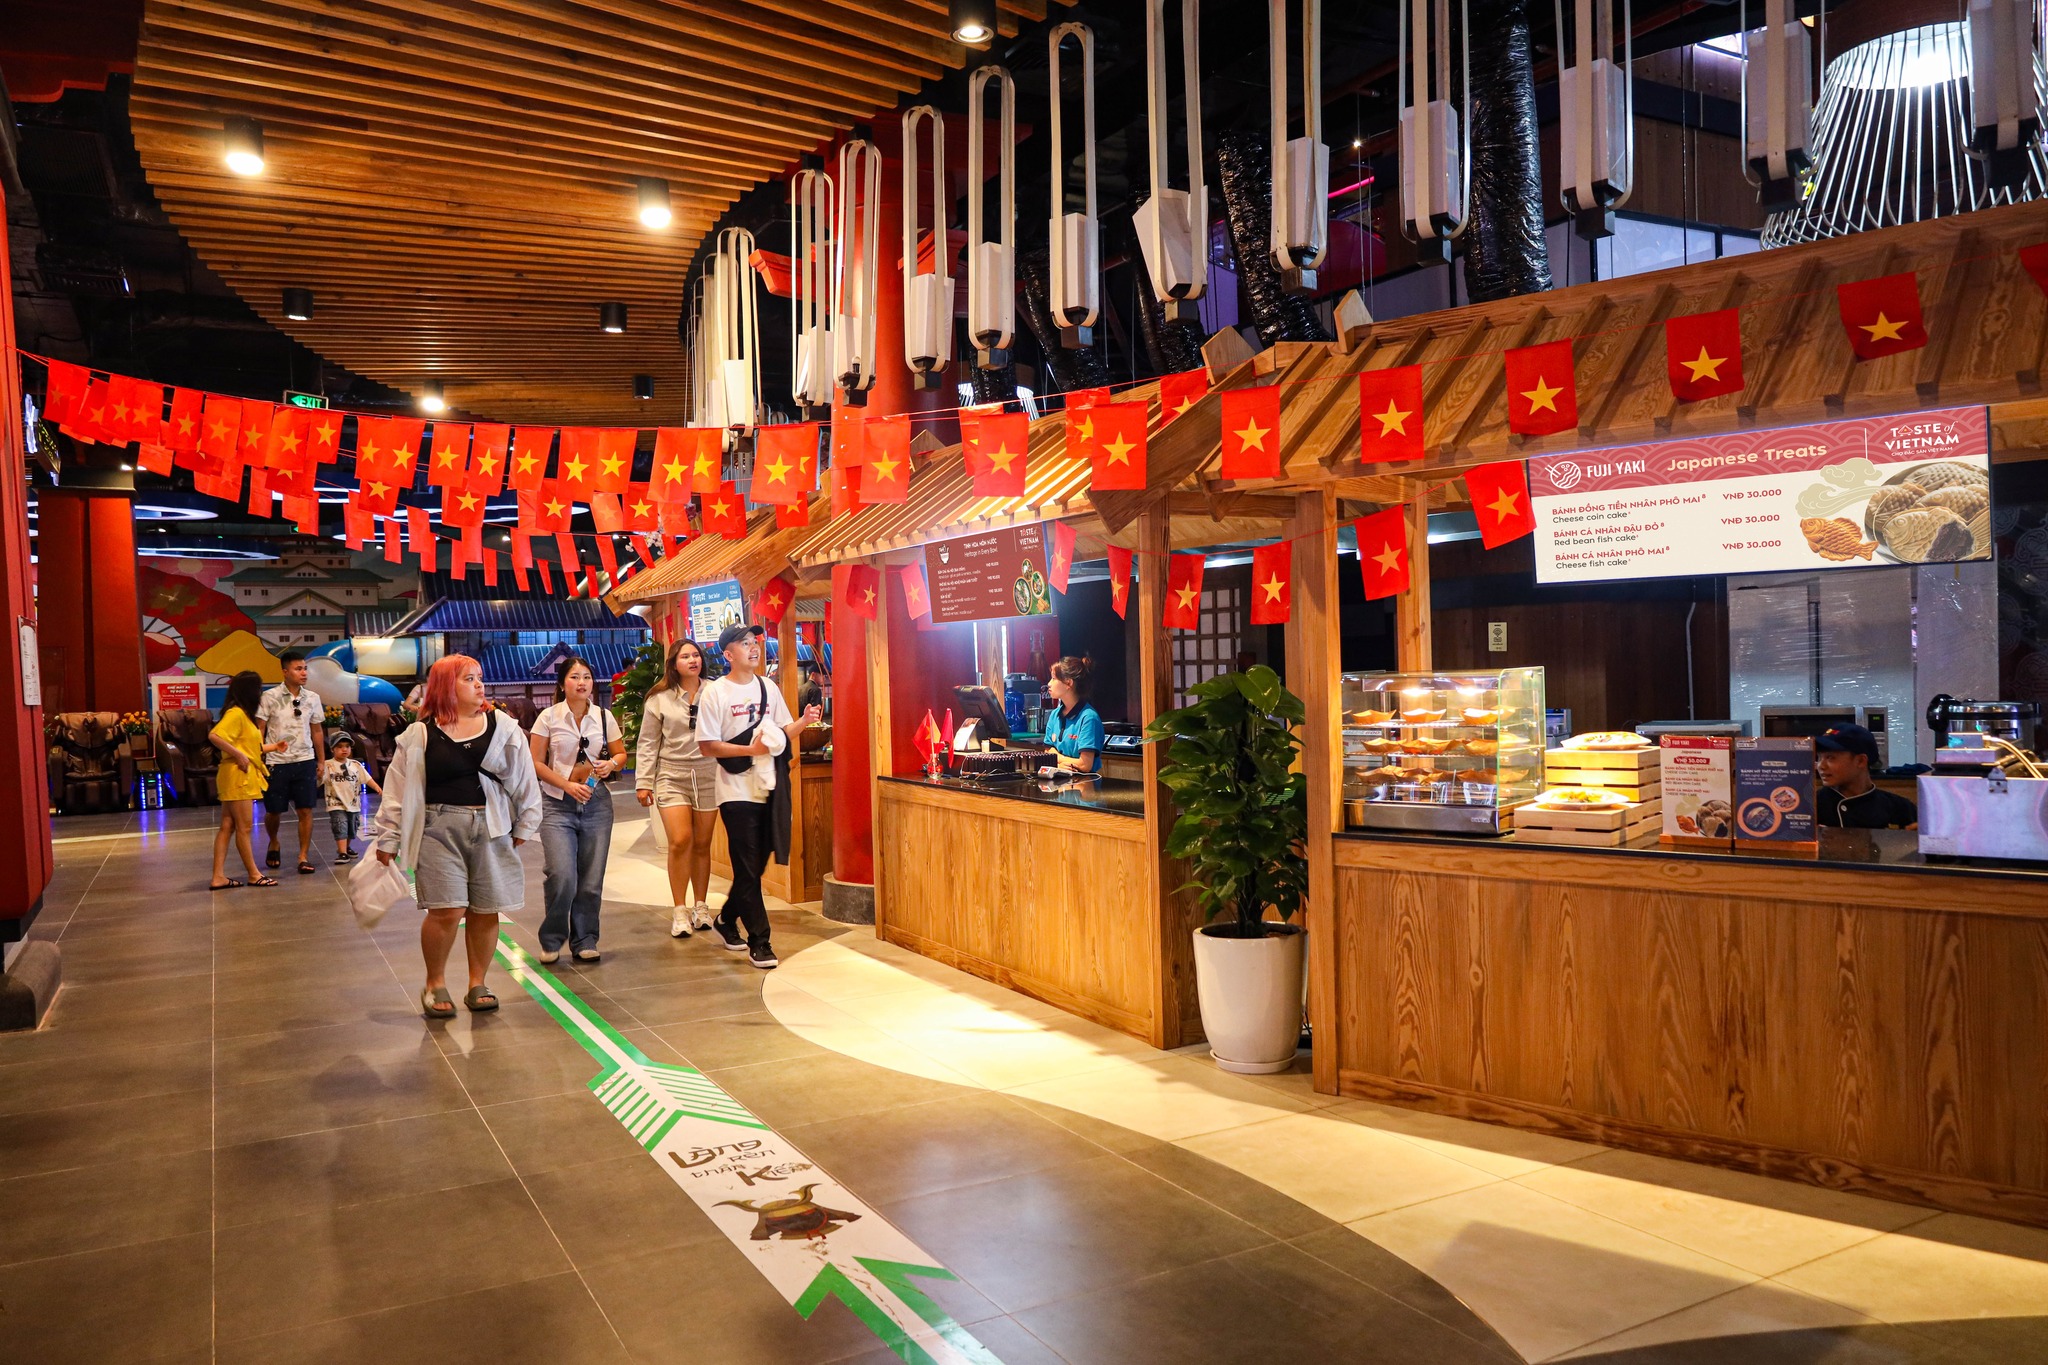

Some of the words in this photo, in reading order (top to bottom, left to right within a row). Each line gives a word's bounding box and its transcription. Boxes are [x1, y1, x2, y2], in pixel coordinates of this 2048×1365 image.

[299, 395, 322, 409] EXIT
[1944, 420, 1958, 434] of
[1884, 434, 1960, 450] VIETNAM
[1667, 452, 1759, 472] Japanese
[1763, 444, 1827, 461] Treats
[1586, 463, 1612, 478] FUJI
[1615, 460, 1646, 474] YAKI
[1722, 491, 1744, 500] VNĐ
[1746, 488, 1782, 499] 30.000
[1552, 506, 1576, 516] BÁNH
[1630, 498, 1657, 509] NHÂN
[1552, 513, 1584, 524] Cheese
[1586, 512, 1604, 521] coin
[1720, 516, 1743, 525] VNĐ
[1745, 514, 1780, 524] 30.000
[1553, 529, 1578, 538] BÁNH
[1580, 527, 1593, 536] CÁ
[1595, 525, 1621, 535] NHÂN
[1573, 537, 1595, 545] bean
[1597, 535, 1613, 543] fish
[1722, 542, 1744, 550] VNĐ
[1746, 539, 1782, 549] 30.000
[1555, 552, 1580, 561] BÁNH
[1582, 550, 1594, 559] CÁ
[1597, 549, 1623, 558] NHÂN
[1556, 560, 1587, 569] Cheese
[1589, 558, 1605, 567] fish
